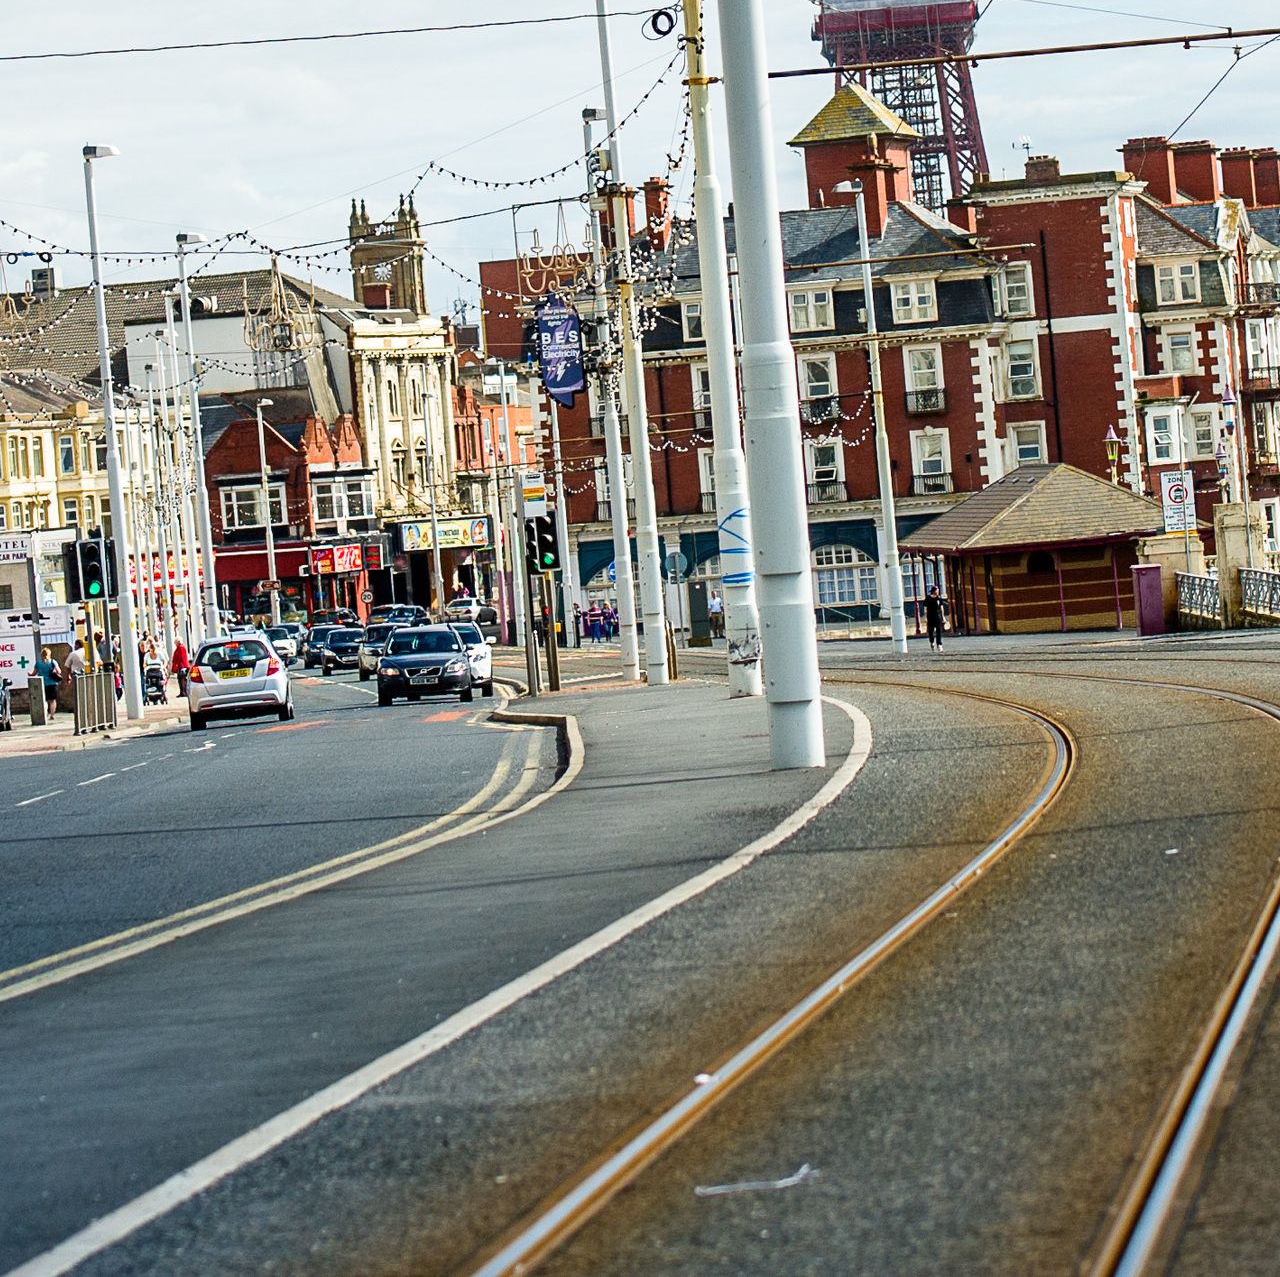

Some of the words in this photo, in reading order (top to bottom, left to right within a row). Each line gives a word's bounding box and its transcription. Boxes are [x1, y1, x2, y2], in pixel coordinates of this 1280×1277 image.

[541, 343, 579, 351] Commercial
[542, 349, 580, 359] Electricity
[12, 552, 28, 560] PARK
[362, 593, 372, 601] 20
